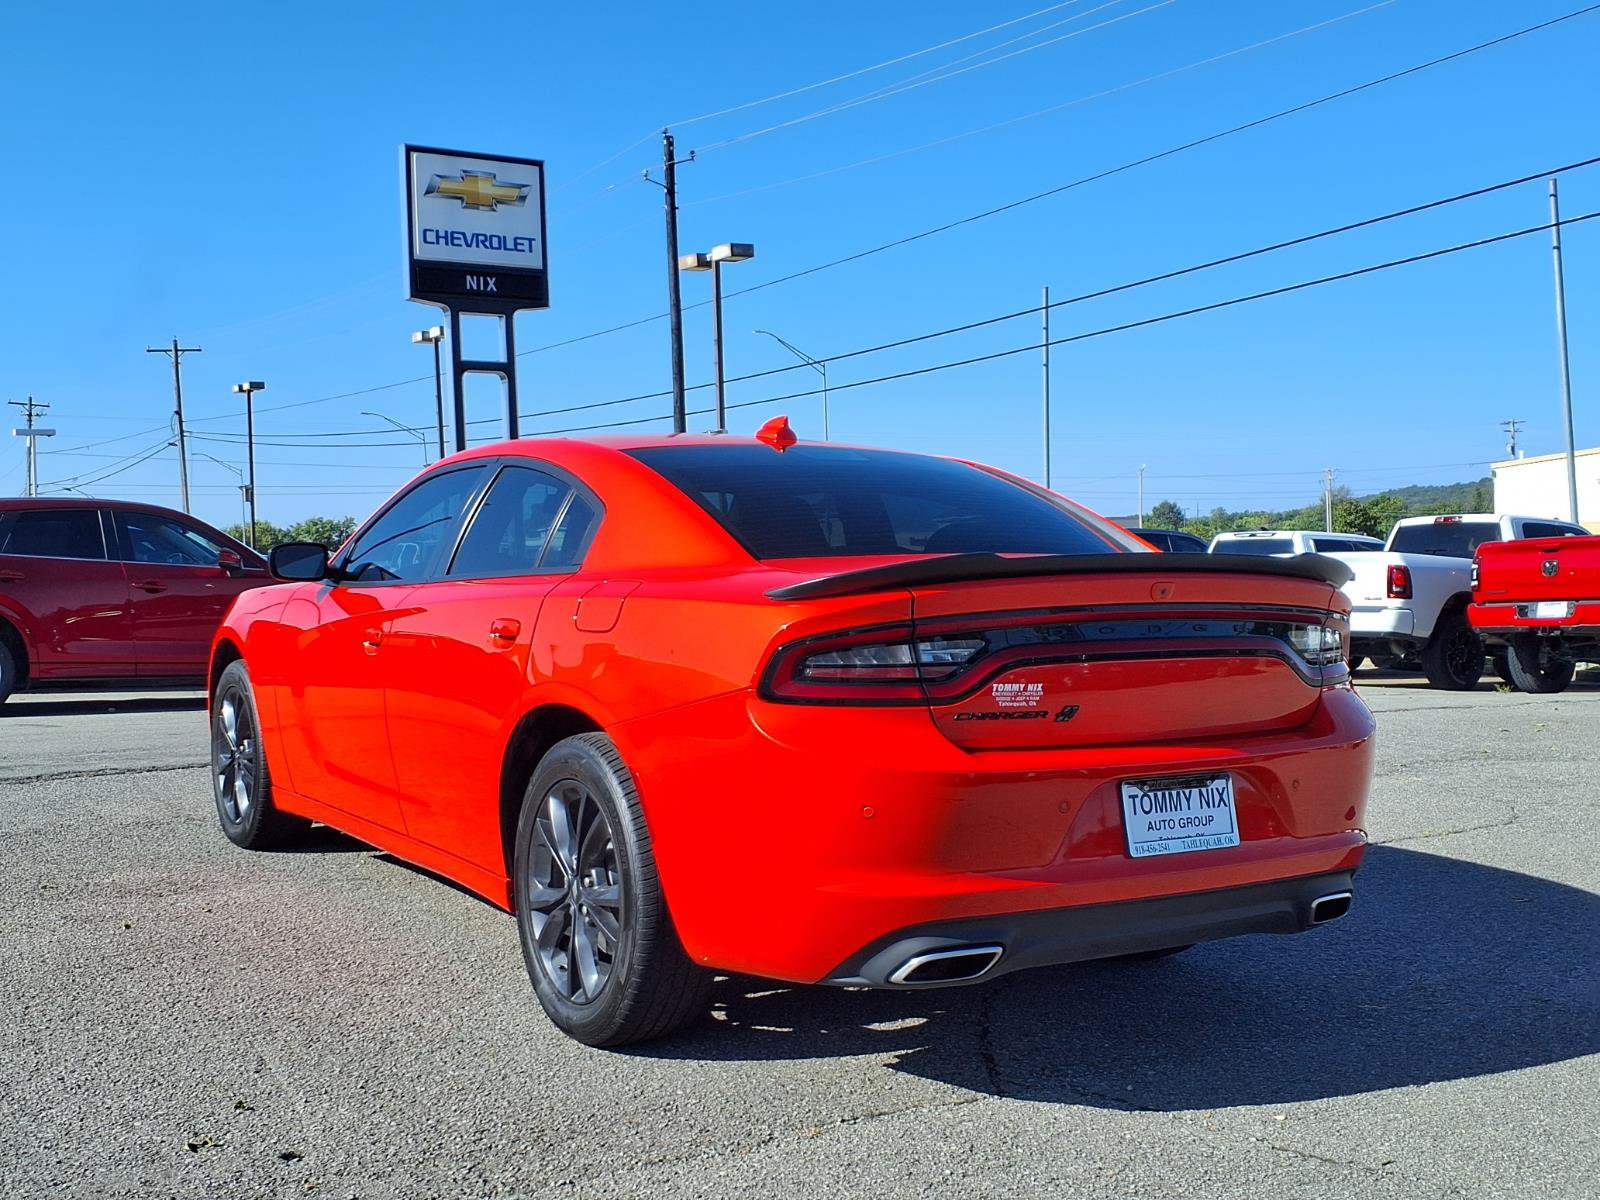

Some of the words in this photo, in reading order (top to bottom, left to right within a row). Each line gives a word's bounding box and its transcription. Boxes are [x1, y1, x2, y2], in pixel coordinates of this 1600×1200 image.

[422, 228, 537, 253] CHEVROLET
[466, 274, 498, 292] NIX
[992, 683, 1026, 692] TOMMY
[1027, 683, 1043, 692] NIX
[953, 710, 1049, 721] CHARGER
[1128, 789, 1193, 816] TOMMY
[1198, 786, 1228, 810] NIX
[1147, 818, 1176, 832] AUTO
[1178, 815, 1215, 829] GROUP
[1134, 841, 1171, 855] 918-456-2541
[1224, 835, 1235, 845] OK
